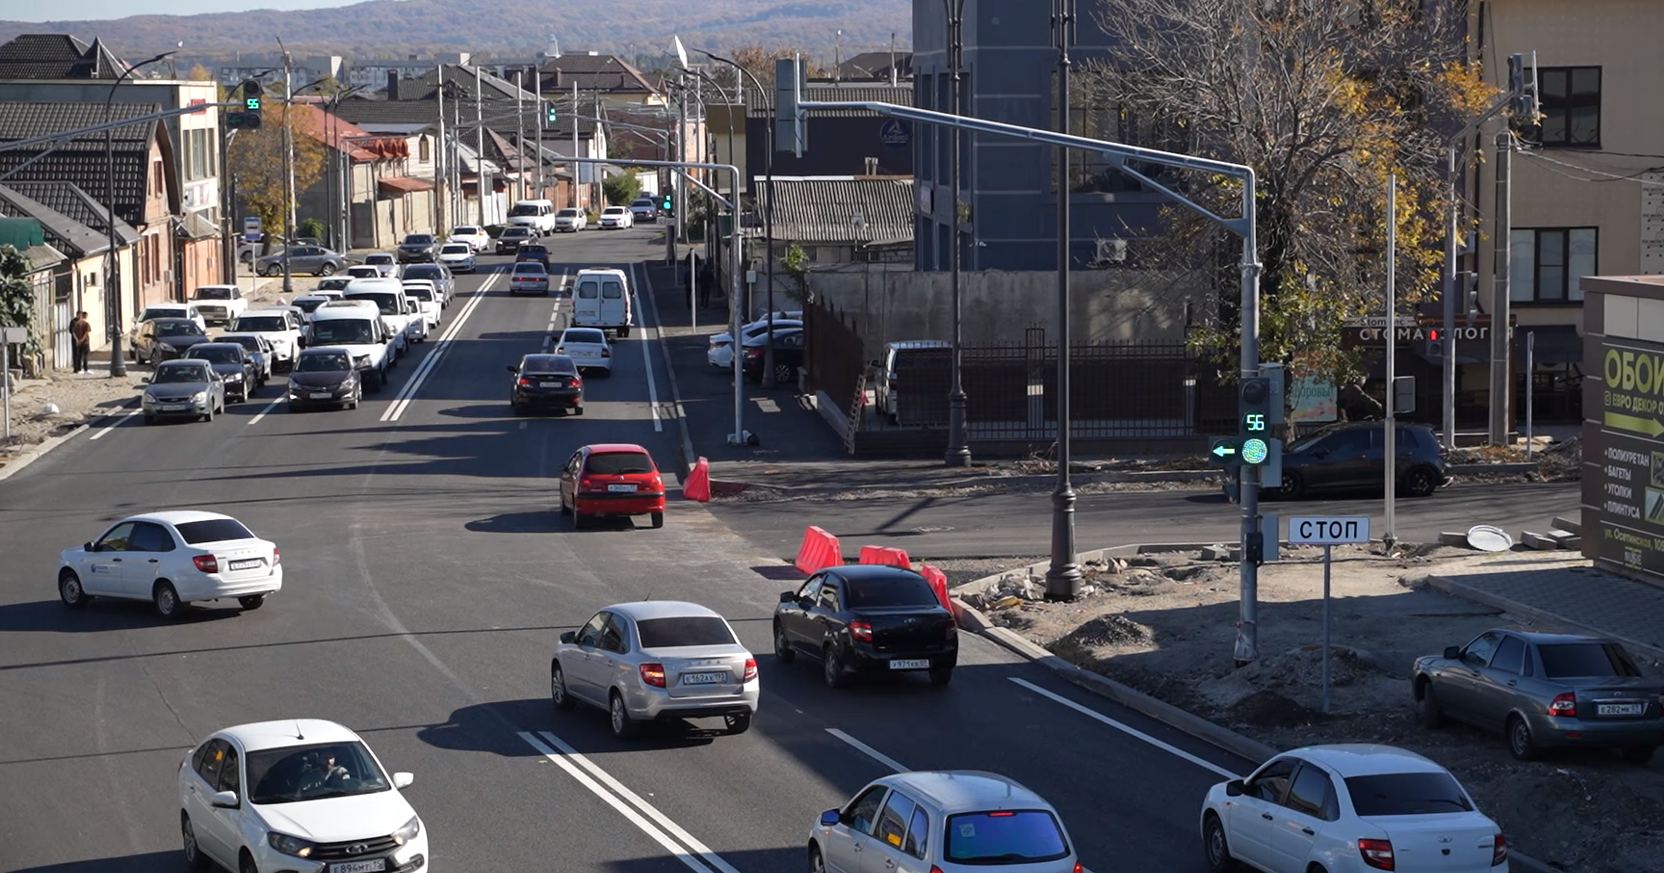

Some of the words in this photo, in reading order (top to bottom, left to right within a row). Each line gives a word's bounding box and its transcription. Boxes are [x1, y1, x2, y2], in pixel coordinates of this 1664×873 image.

[1604, 348, 1664, 396] ОБОИ
[1612, 393, 1632, 409] ЕВРО
[1632, 396, 1657, 413] ДЕКОР
[1246, 414, 1265, 431] 56
[1608, 447, 1649, 467] ПОЛИУРЕТАН
[1608, 465, 1632, 481] БАГЕТЫ
[1607, 483, 1632, 499] УГОЛКИ
[1607, 500, 1640, 519] ПЛИНТУСА
[1299, 520, 1358, 539] СТОП
